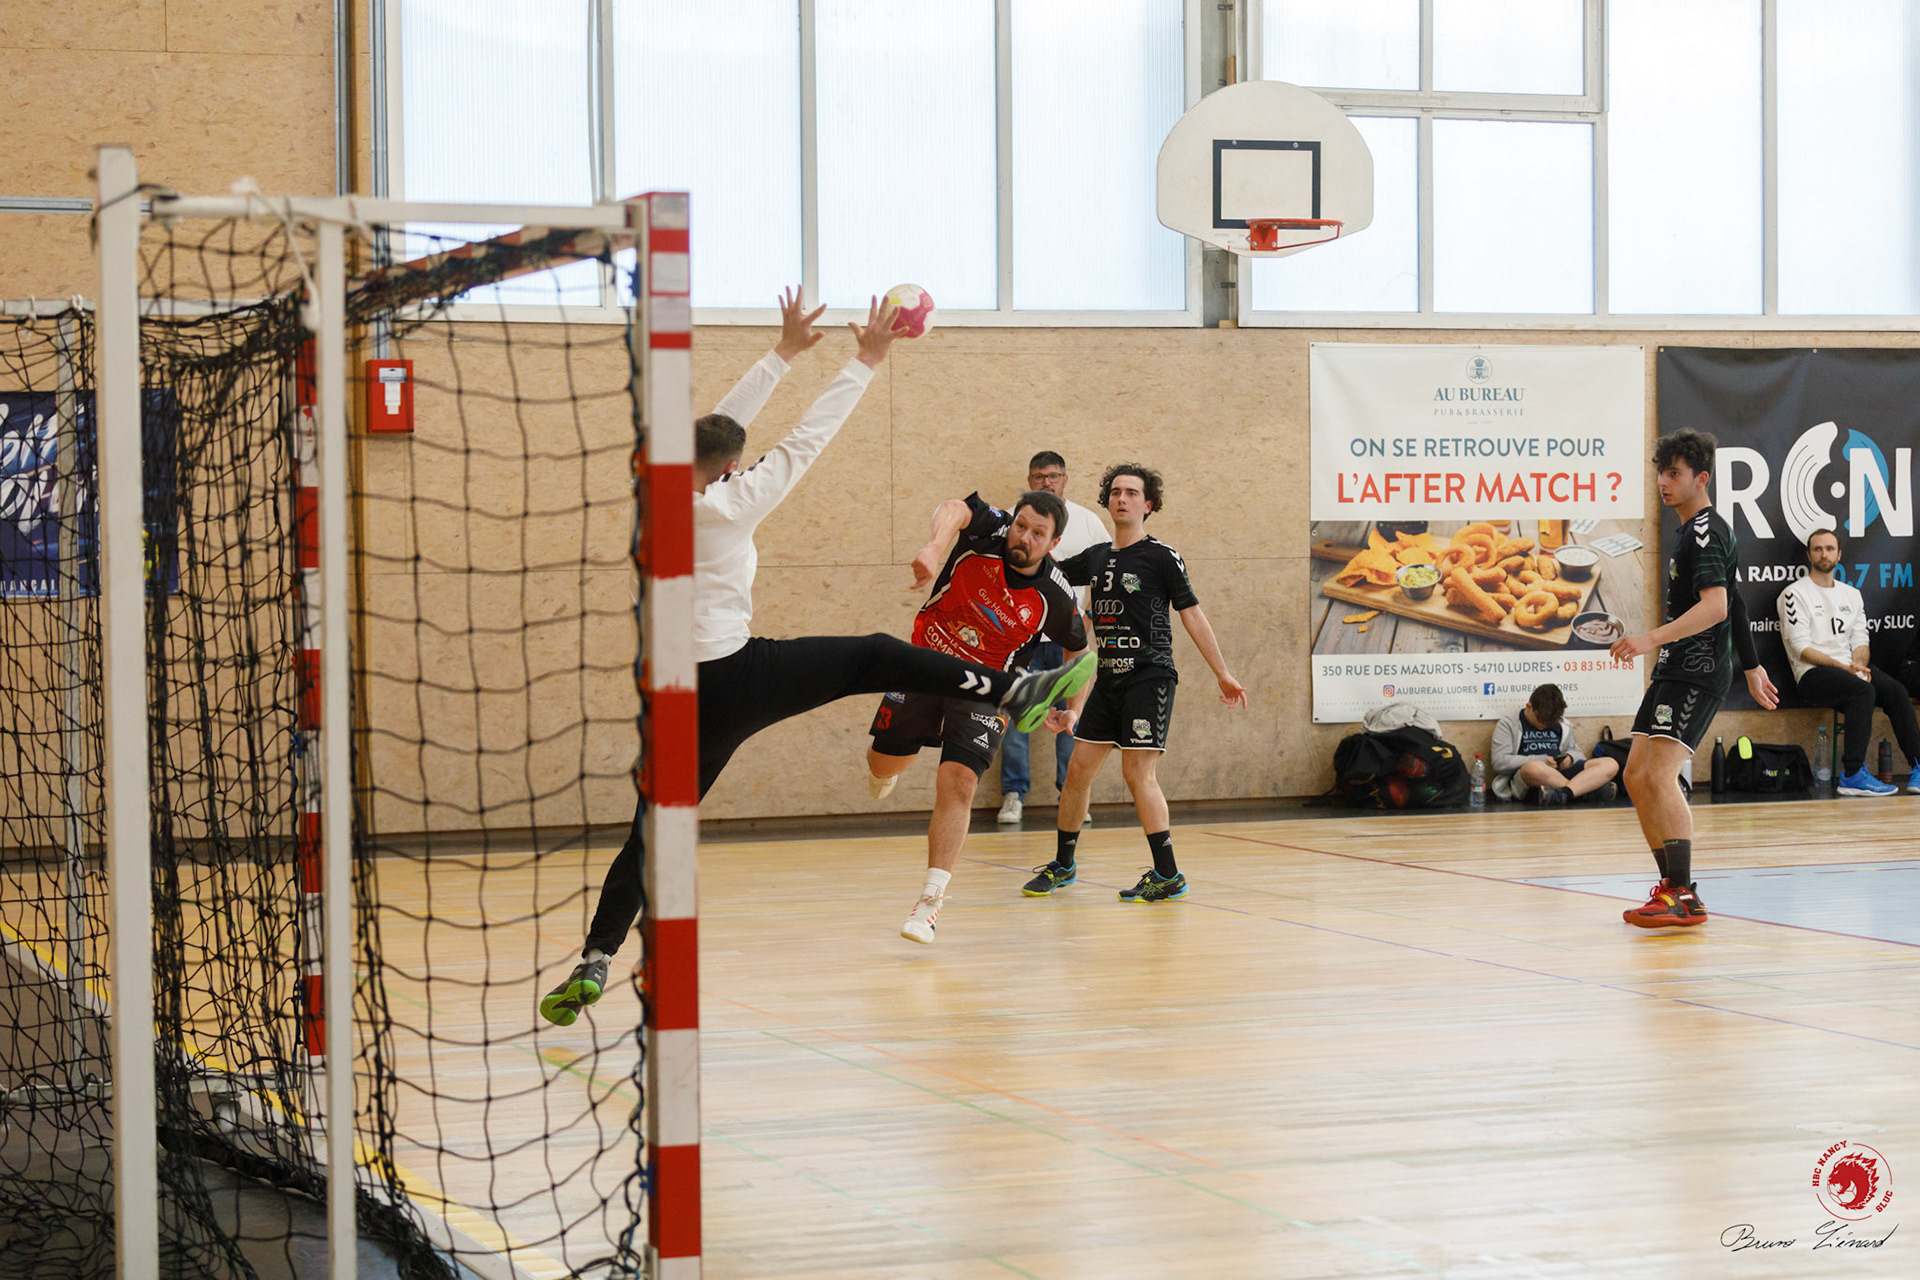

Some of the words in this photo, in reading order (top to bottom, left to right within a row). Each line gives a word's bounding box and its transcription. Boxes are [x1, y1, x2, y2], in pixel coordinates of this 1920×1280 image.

[1434, 387, 1456, 402] AU
[1459, 387, 1525, 402] BUREAU
[1350, 438, 1385, 457] ON
[1392, 438, 1417, 457] SE
[1424, 438, 1540, 457] RETROUVE
[1547, 438, 1605, 457] POUR
[1337, 472, 1466, 503] L'AFTER
[1475, 472, 1596, 503] MATCH
[1606, 471, 1623, 502] ?
[1715, 421, 1914, 547] RCN
[1103, 571, 1114, 591] 3
[1748, 565, 1809, 582] RADIO
[1833, 563, 1870, 588] 0.7
[1880, 563, 1913, 588] FM
[978, 588, 991, 605] Guy
[990, 602, 1017, 629] Hoquet
[1750, 618, 1780, 632] naire
[1866, 618, 1881, 633] cy
[1884, 615, 1915, 629] SLUC
[1831, 617, 1845, 635] 12
[927, 626, 965, 660] COMPT
[1322, 666, 1342, 676] 350
[1345, 665, 1370, 676] RUE
[1374, 664, 1397, 676] DES
[1400, 663, 1463, 675] MAZUROTS
[1474, 662, 1504, 673] 54710
[1508, 661, 1553, 673] LUDRES
[1563, 661, 1578, 672] 03
[1580, 661, 1593, 672] 83
[1596, 660, 1606, 671] 51
[1621, 660, 1634, 670] 68
[1396, 685, 1478, 696] AUBUREAU_LUDRES
[1497, 685, 1509, 693] AU
[1510, 684, 1537, 693] BUREA
[1558, 683, 1579, 692] DRES
[1523, 731, 1550, 739] JACK
